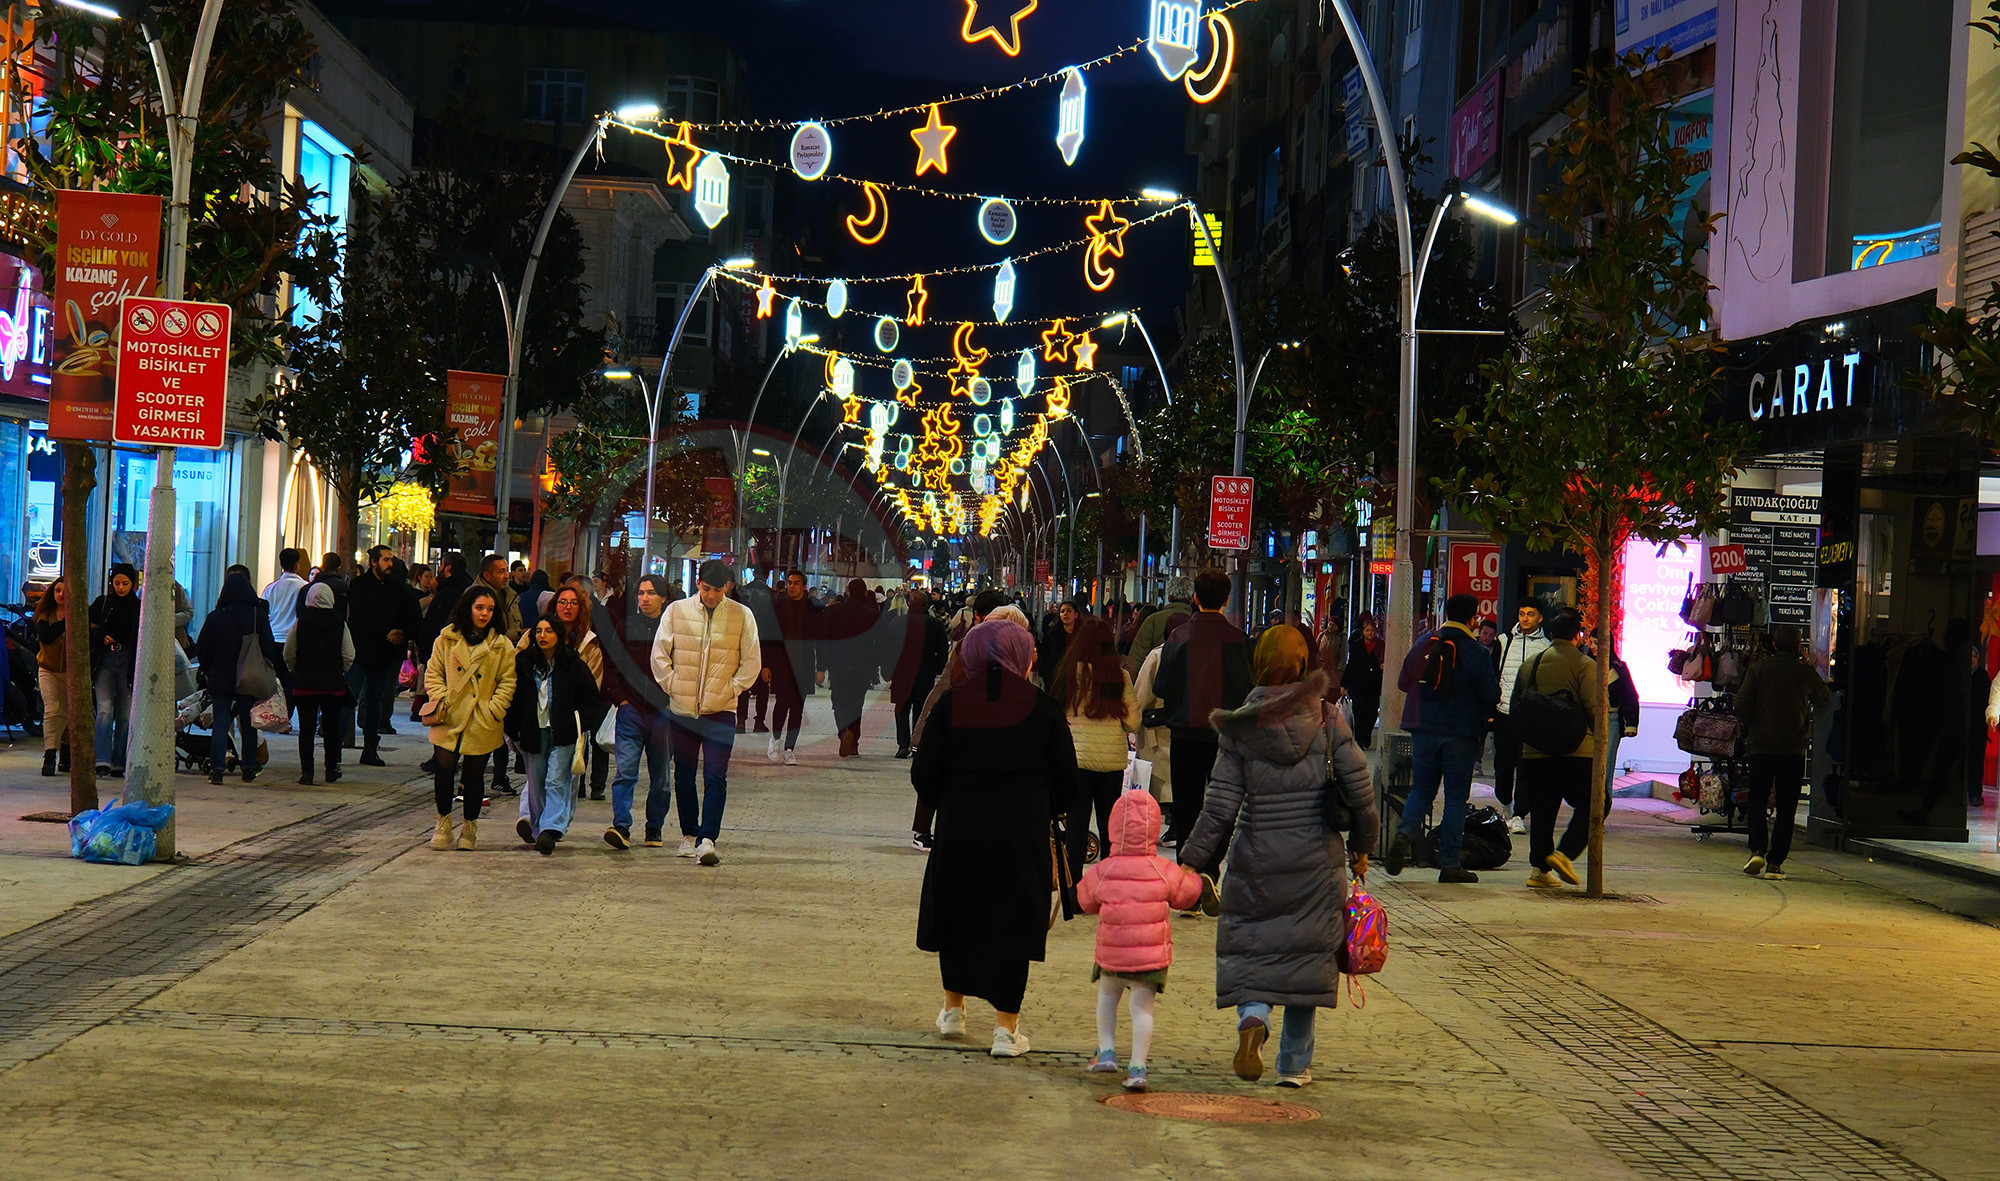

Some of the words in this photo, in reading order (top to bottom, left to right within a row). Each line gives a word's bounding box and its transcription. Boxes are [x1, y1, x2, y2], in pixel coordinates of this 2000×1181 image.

[80, 230, 98, 241] DY
[100, 231, 138, 243] GOLD
[67, 244, 119, 266] İŞÇİLİK
[121, 250, 149, 267] YOK
[65, 267, 118, 286] KAZANÇ
[126, 340, 221, 358] MOTOSİKLET
[139, 357, 207, 373] BİSİKLET
[162, 377, 181, 389] VE
[1748, 350, 1861, 421] CARAT
[136, 391, 205, 407] SCOOTER
[138, 407, 201, 423] GİRMESİ
[451, 413, 479, 426] KAZANÇ
[131, 425, 205, 440] YASAKTIR
[464, 419, 496, 441] çok!
[1214, 496, 1250, 505] MOTOSİKLET
[1734, 495, 1819, 511] KUNDAKÇIOĞLU
[1217, 521, 1243, 529] SCOOTER
[1779, 514, 1799, 522] KAT
[1217, 529, 1241, 537] GİRMESİ
[1780, 530, 1793, 538] TERZİ
[1470, 578, 1492, 592] GB
